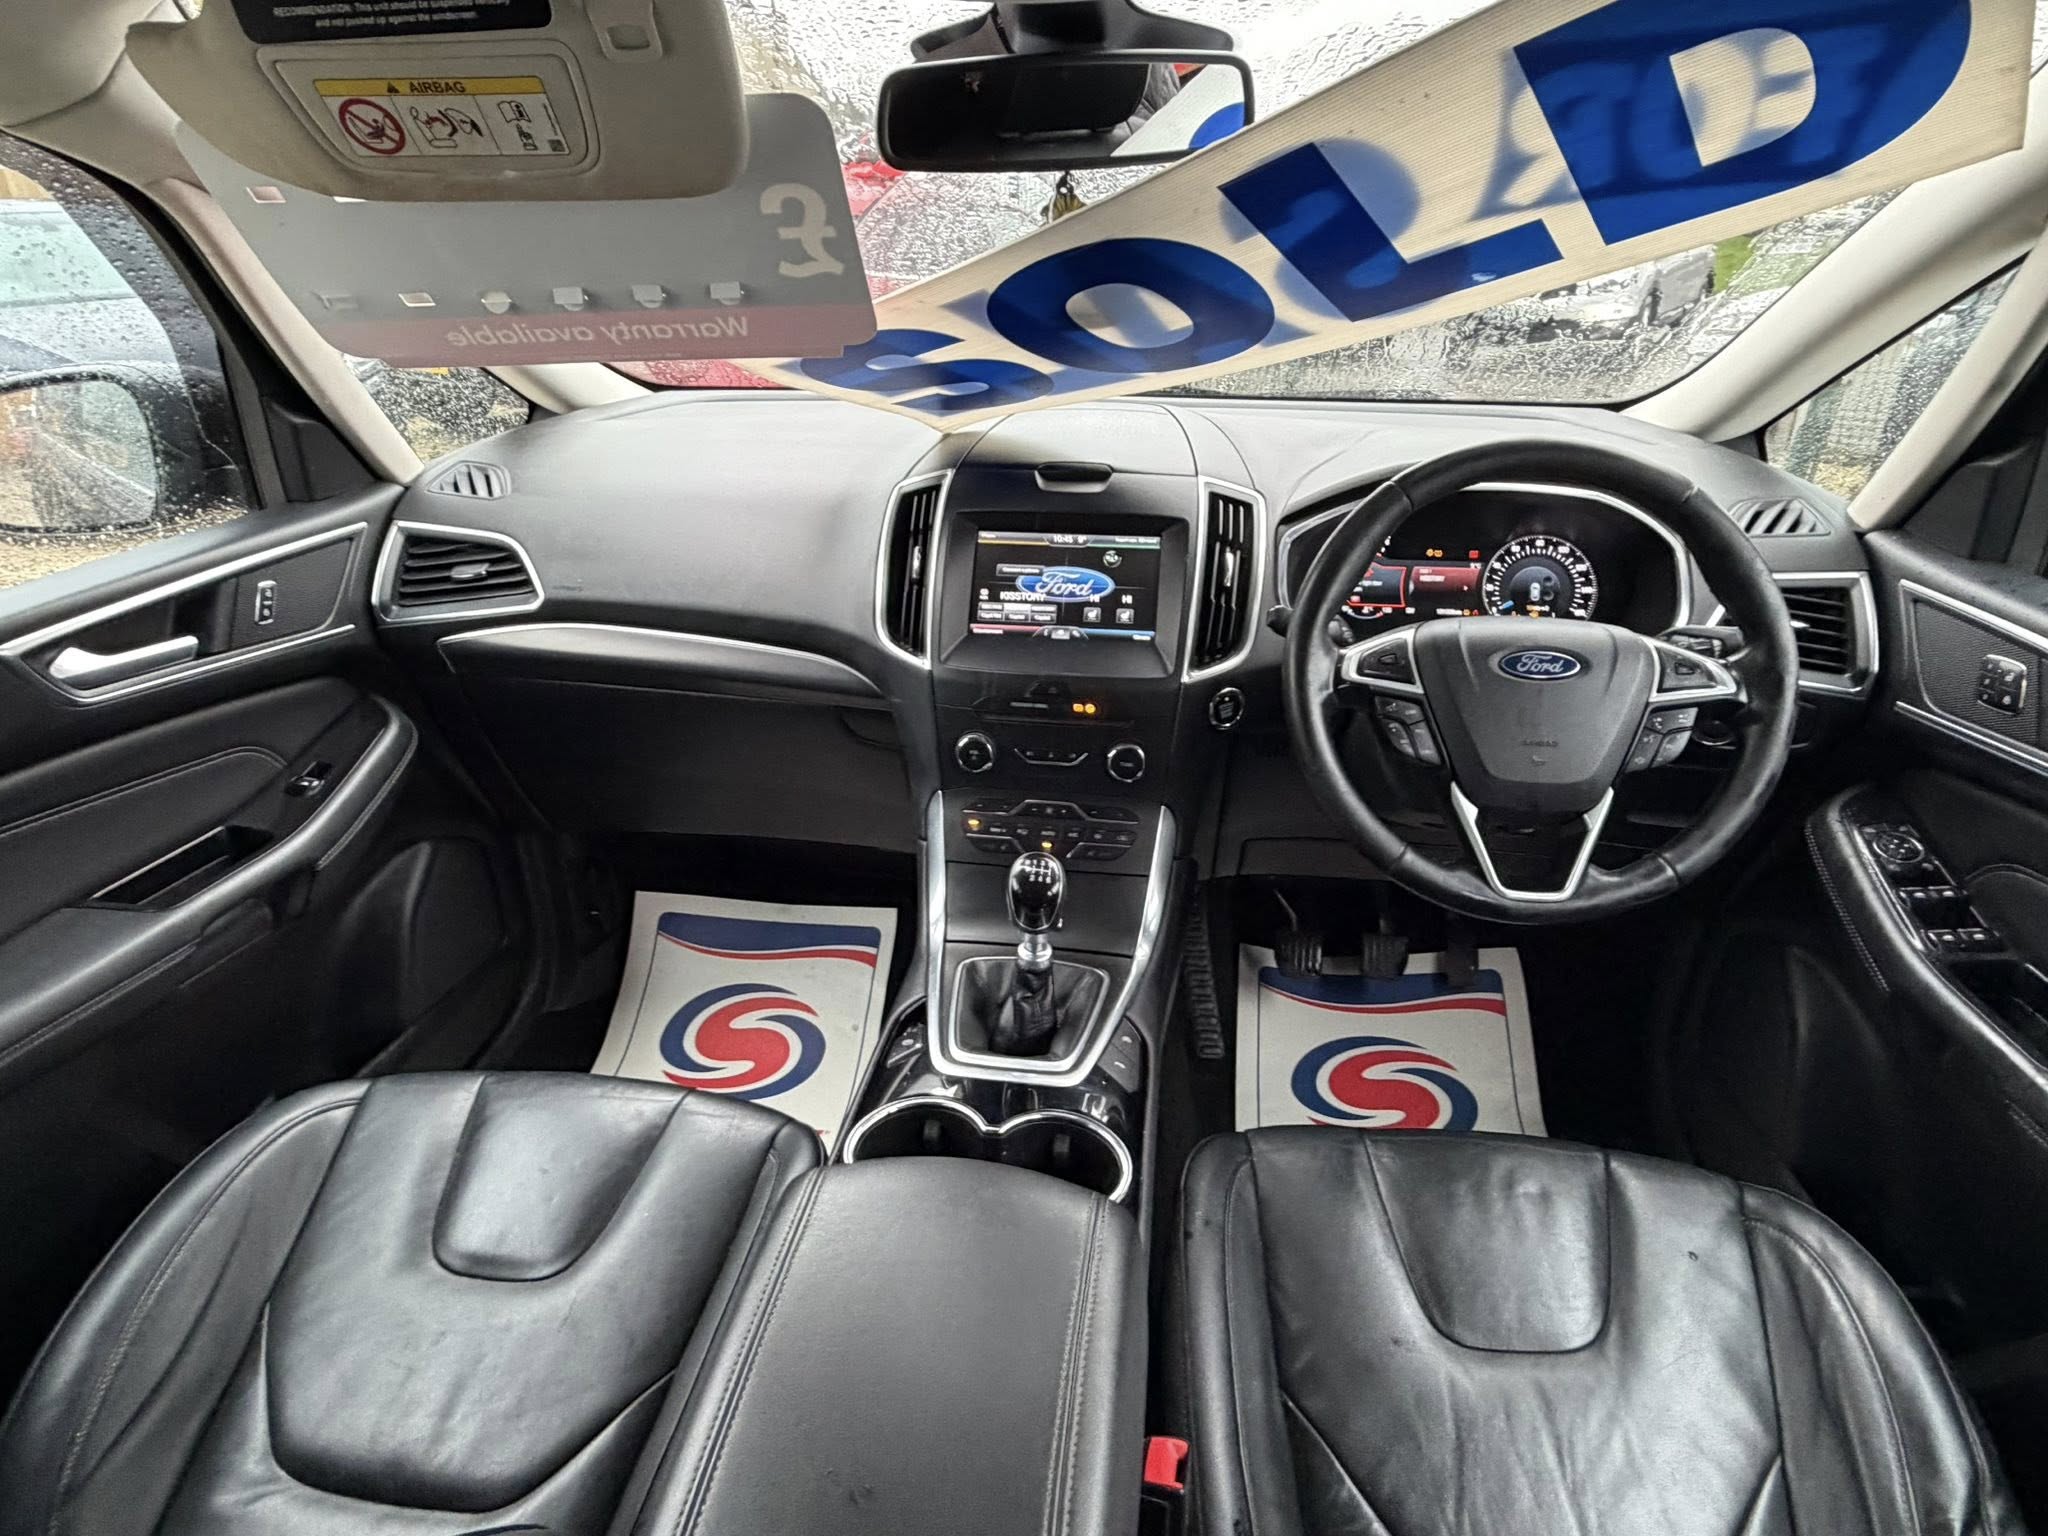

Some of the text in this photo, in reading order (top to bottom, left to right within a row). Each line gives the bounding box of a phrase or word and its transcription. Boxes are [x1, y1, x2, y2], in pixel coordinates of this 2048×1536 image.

[409, 81, 467, 94] AIRBAG
[800, 0, 1973, 417] SOLD
[1035, 571, 1094, 596] Ford
[1516, 653, 1564, 673] Ford
